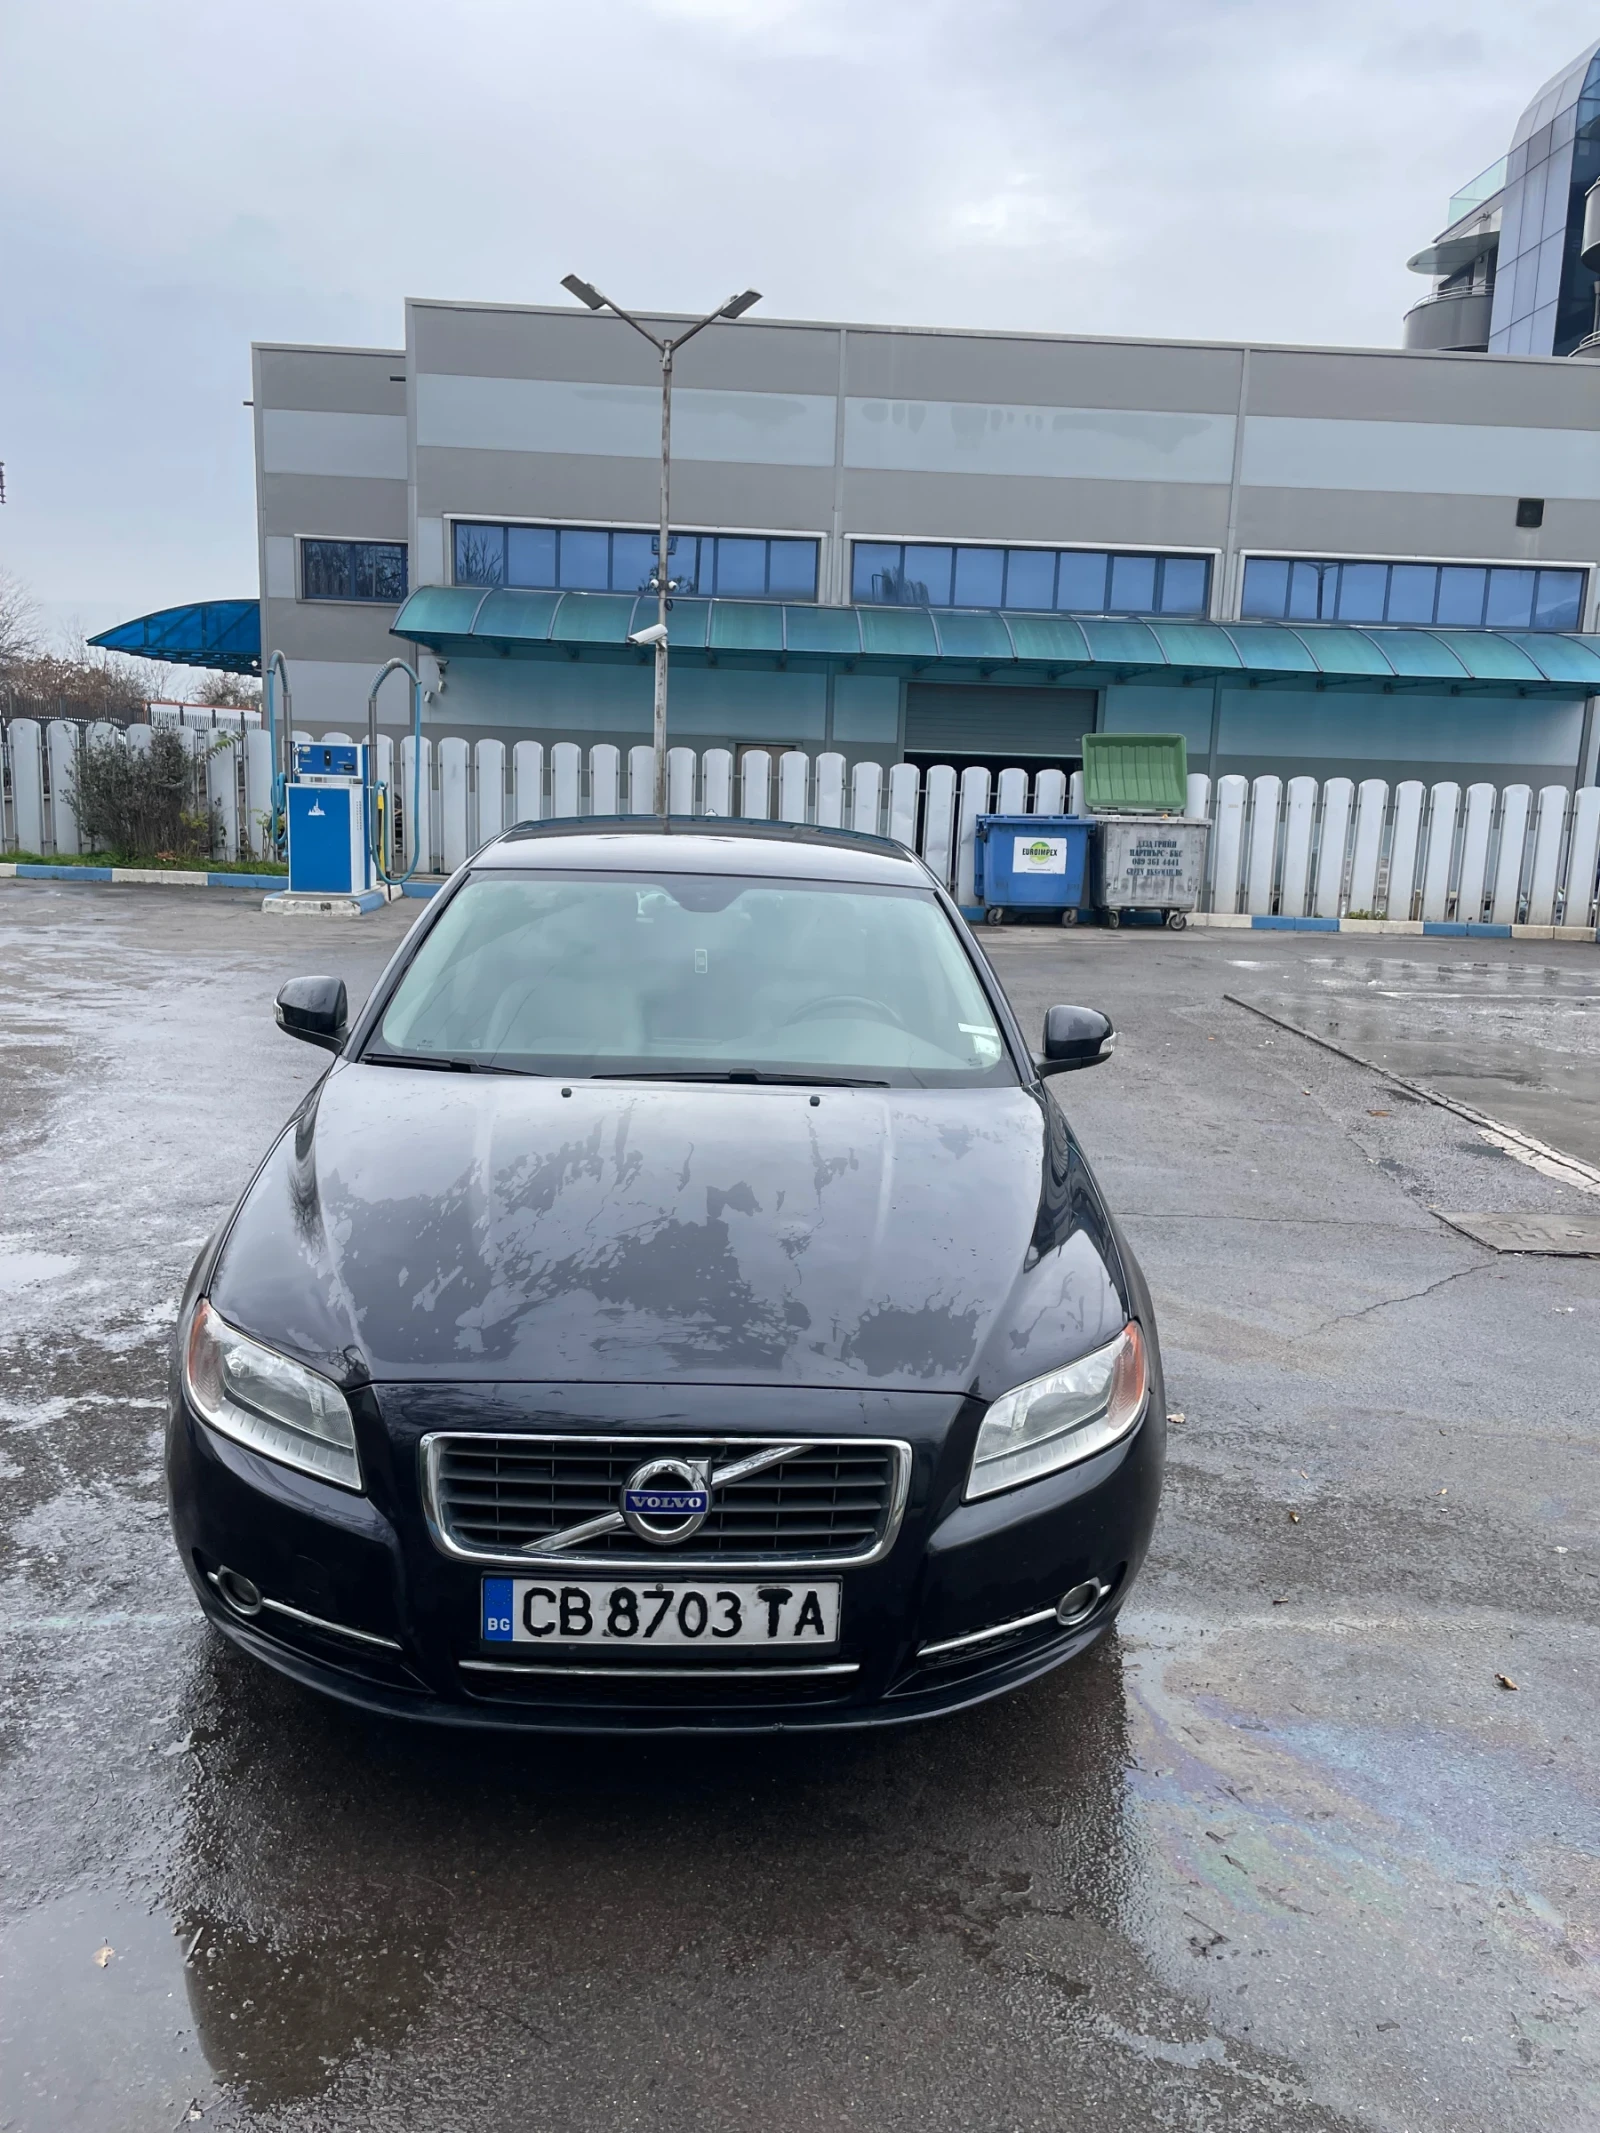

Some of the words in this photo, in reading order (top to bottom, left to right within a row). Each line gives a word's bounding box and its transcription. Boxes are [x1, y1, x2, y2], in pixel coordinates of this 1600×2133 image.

[1154, 839, 1177, 848] ГРИЙН
[1022, 847, 1058, 857] EUROIMPEX
[1132, 857, 1146, 866] 089
[1147, 858, 1160, 866] 361
[630, 1496, 702, 1509] VOLVO
[522, 1586, 594, 1638] CB
[606, 1586, 742, 1639] 8703
[757, 1586, 825, 1639] TA
[487, 1617, 511, 1632] BG
